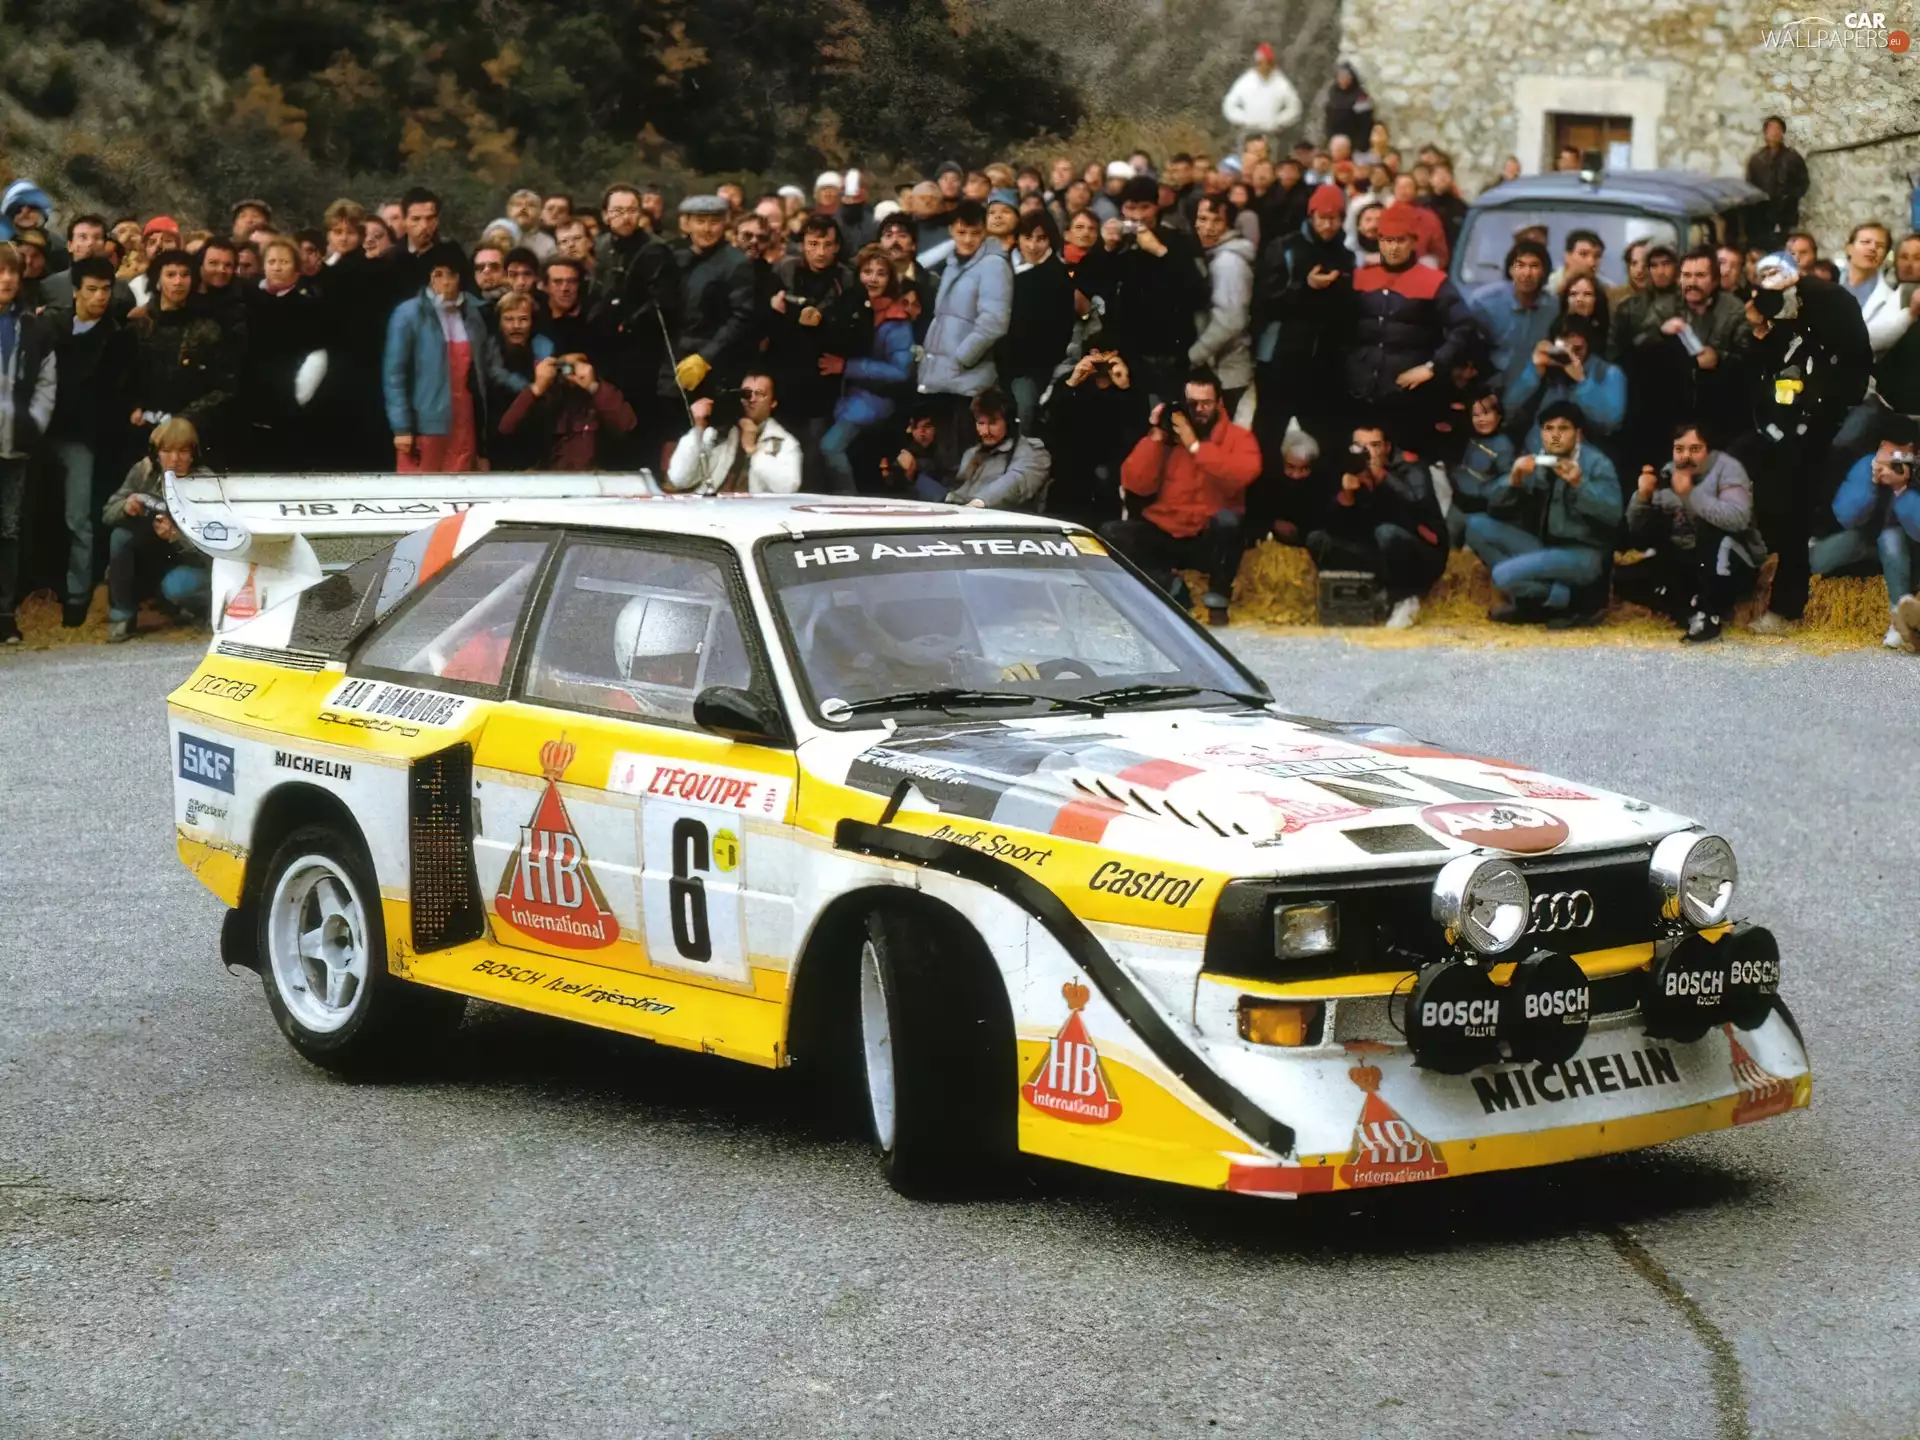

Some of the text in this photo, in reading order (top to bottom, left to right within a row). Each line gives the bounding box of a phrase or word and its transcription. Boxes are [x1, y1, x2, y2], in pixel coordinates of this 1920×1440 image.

[279, 503, 338, 517] HB
[794, 545, 860, 568] HB
[962, 539, 1079, 557] TEAM
[183, 742, 231, 781] SKF
[274, 750, 352, 781] MICHELIN
[519, 826, 583, 908] HB
[981, 835, 1053, 866] Sport
[668, 817, 713, 962] 6
[1088, 861, 1205, 909] Castrol
[511, 904, 605, 940] international
[472, 959, 547, 985] BOSCH
[1665, 970, 1724, 996] BOSCH
[1422, 1000, 1499, 1027] BOSCH
[1524, 986, 1589, 1019] BOSCH
[1047, 1037, 1098, 1097] HB
[1471, 1047, 1680, 1114] MICHELIN
[1356, 1120, 1424, 1164] HB
